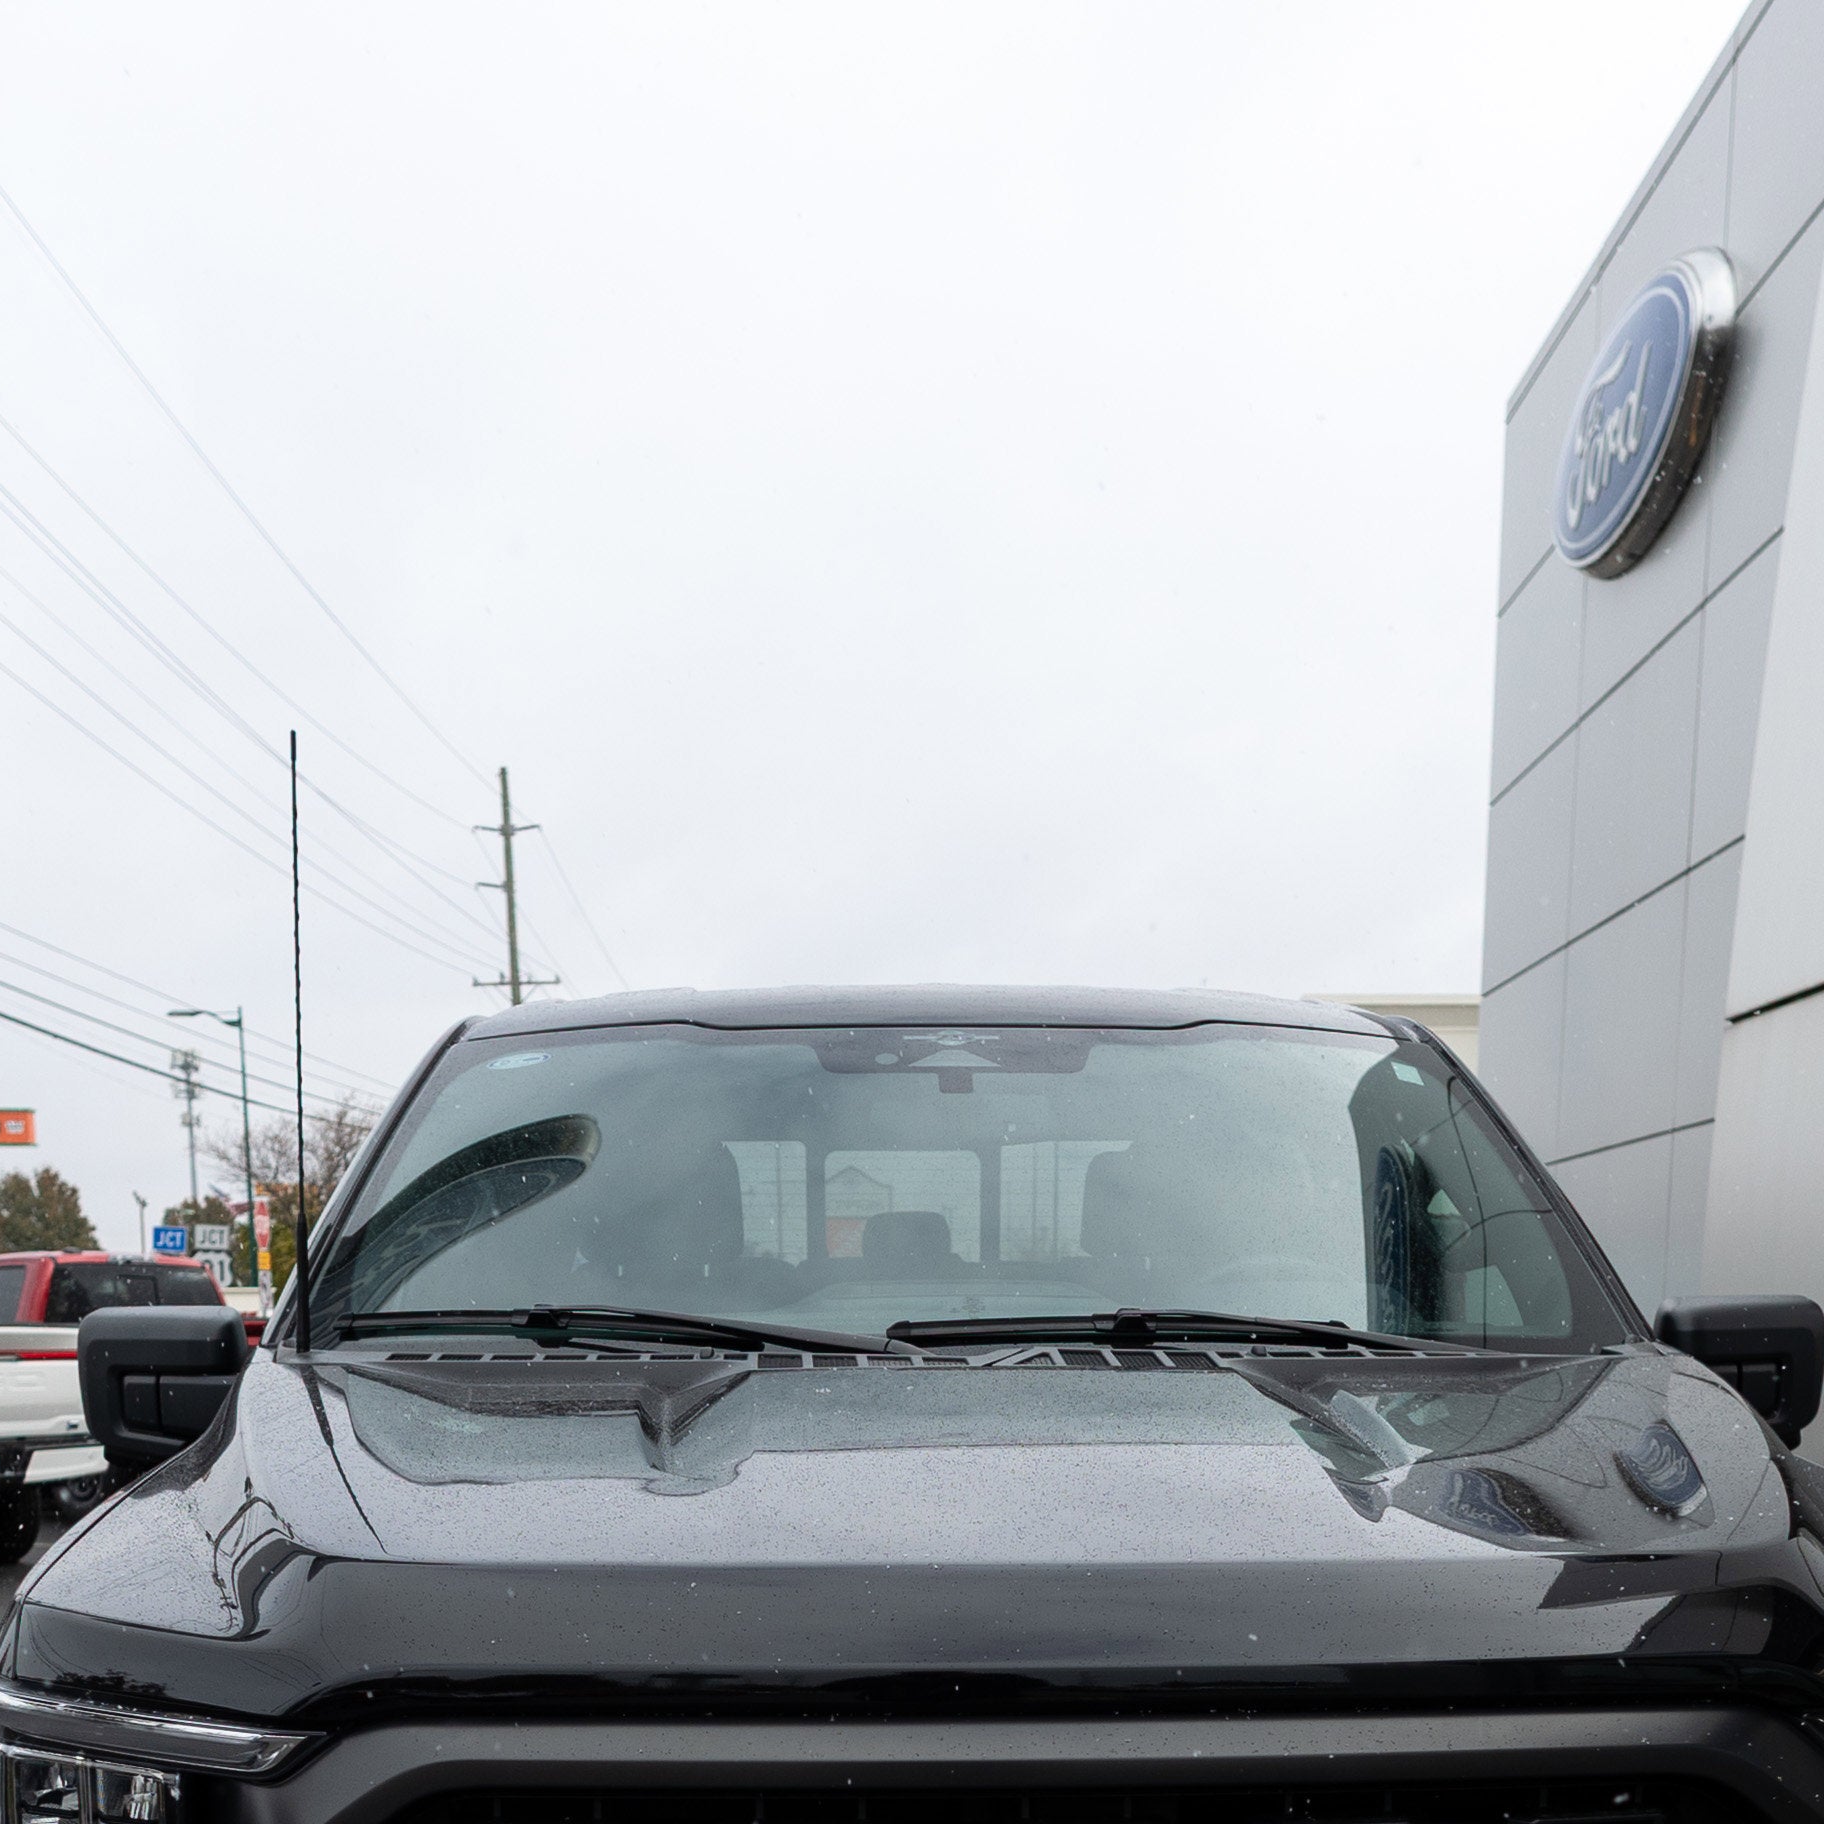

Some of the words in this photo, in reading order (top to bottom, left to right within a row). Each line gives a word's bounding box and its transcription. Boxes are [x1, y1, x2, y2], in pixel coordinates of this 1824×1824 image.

[1567, 338, 1653, 530] Ford
[156, 1230, 184, 1248] JCT
[199, 1229, 225, 1246] JCT
